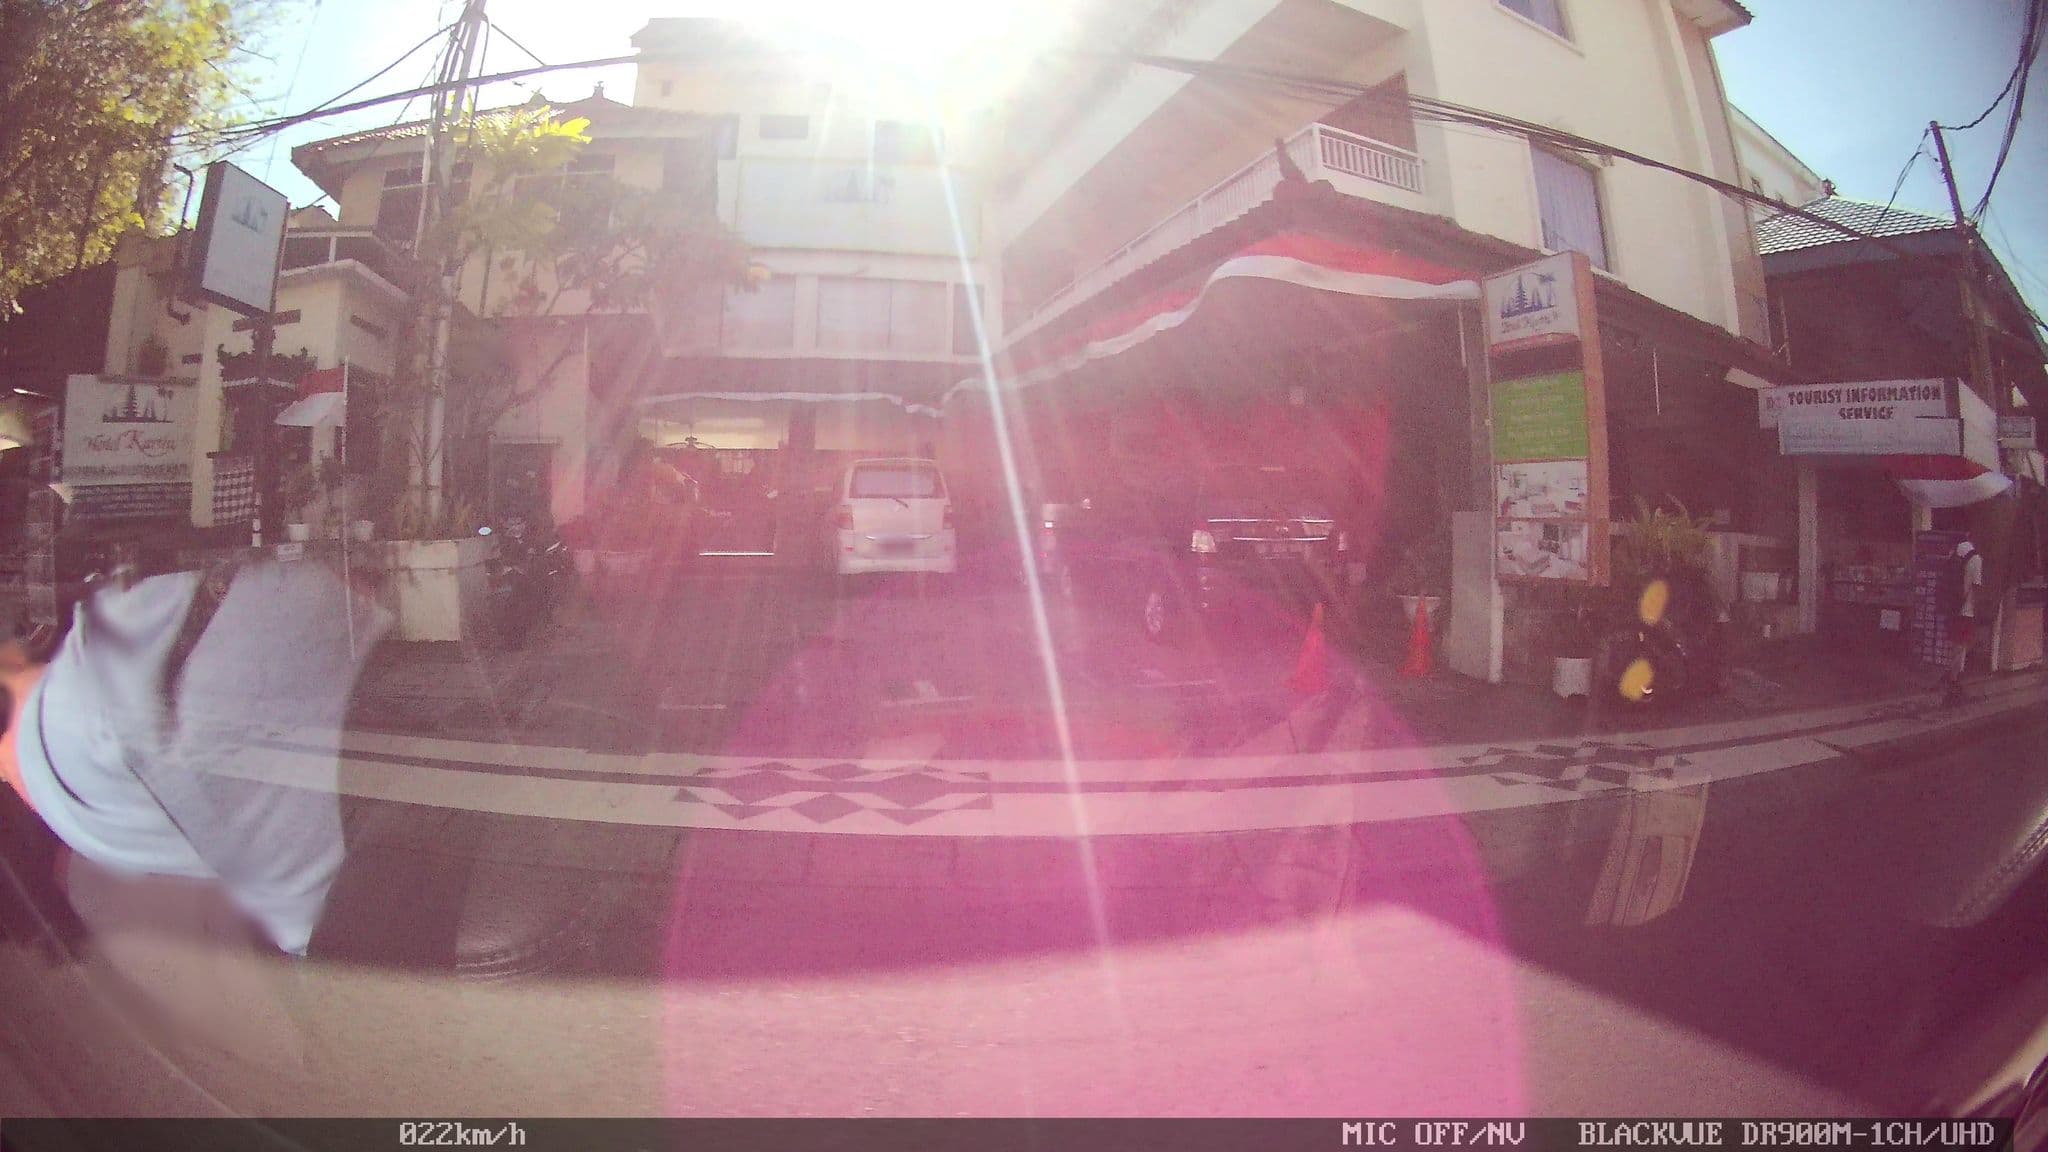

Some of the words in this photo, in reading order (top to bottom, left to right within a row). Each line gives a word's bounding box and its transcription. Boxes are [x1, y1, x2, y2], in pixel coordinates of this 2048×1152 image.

[1787, 389, 1842, 406] TOURIST
[1846, 385, 1942, 404] INFORMATION
[1838, 406, 1894, 420] SERVICE
